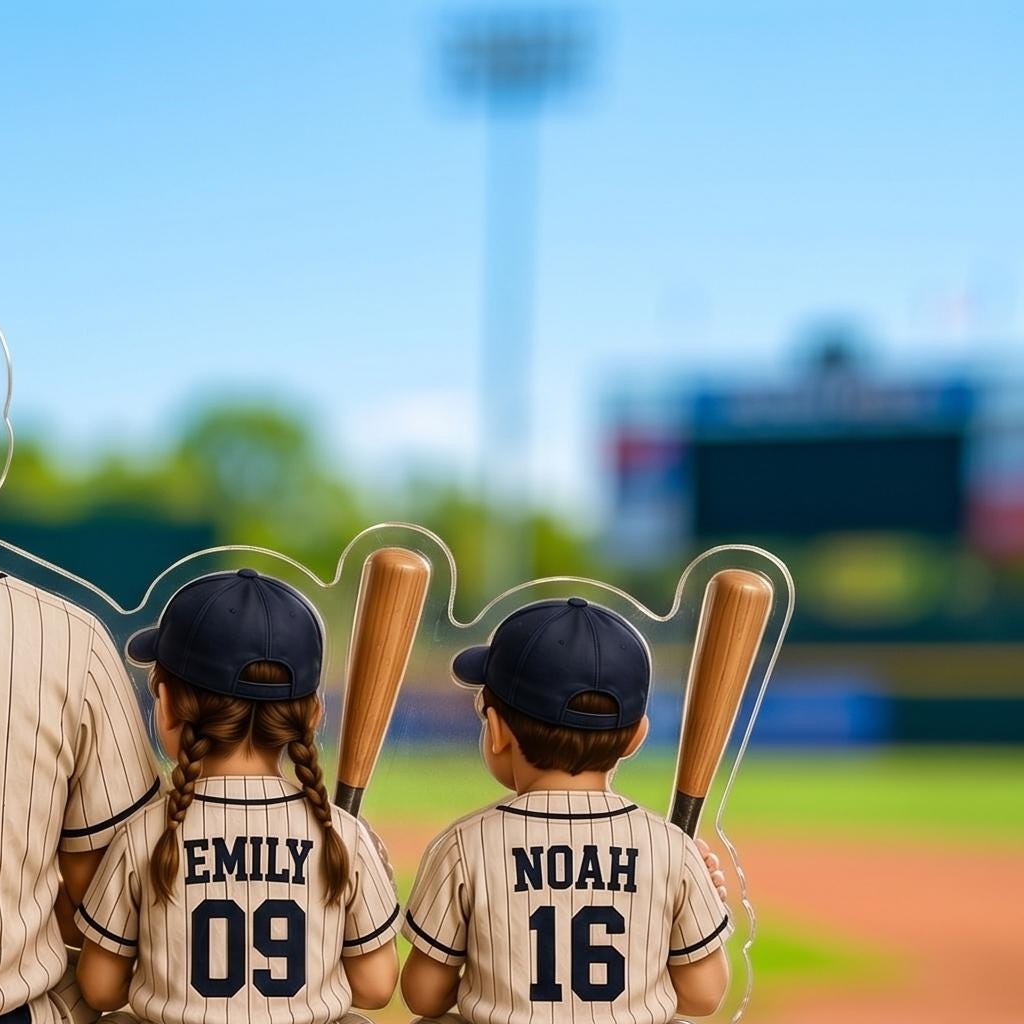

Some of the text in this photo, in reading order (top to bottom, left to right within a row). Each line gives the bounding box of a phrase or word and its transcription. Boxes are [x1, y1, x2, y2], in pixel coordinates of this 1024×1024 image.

[183, 837, 313, 885] EMILY
[512, 846, 639, 893] NOAH
[191, 898, 306, 998] 09
[529, 906, 625, 1002] 16
